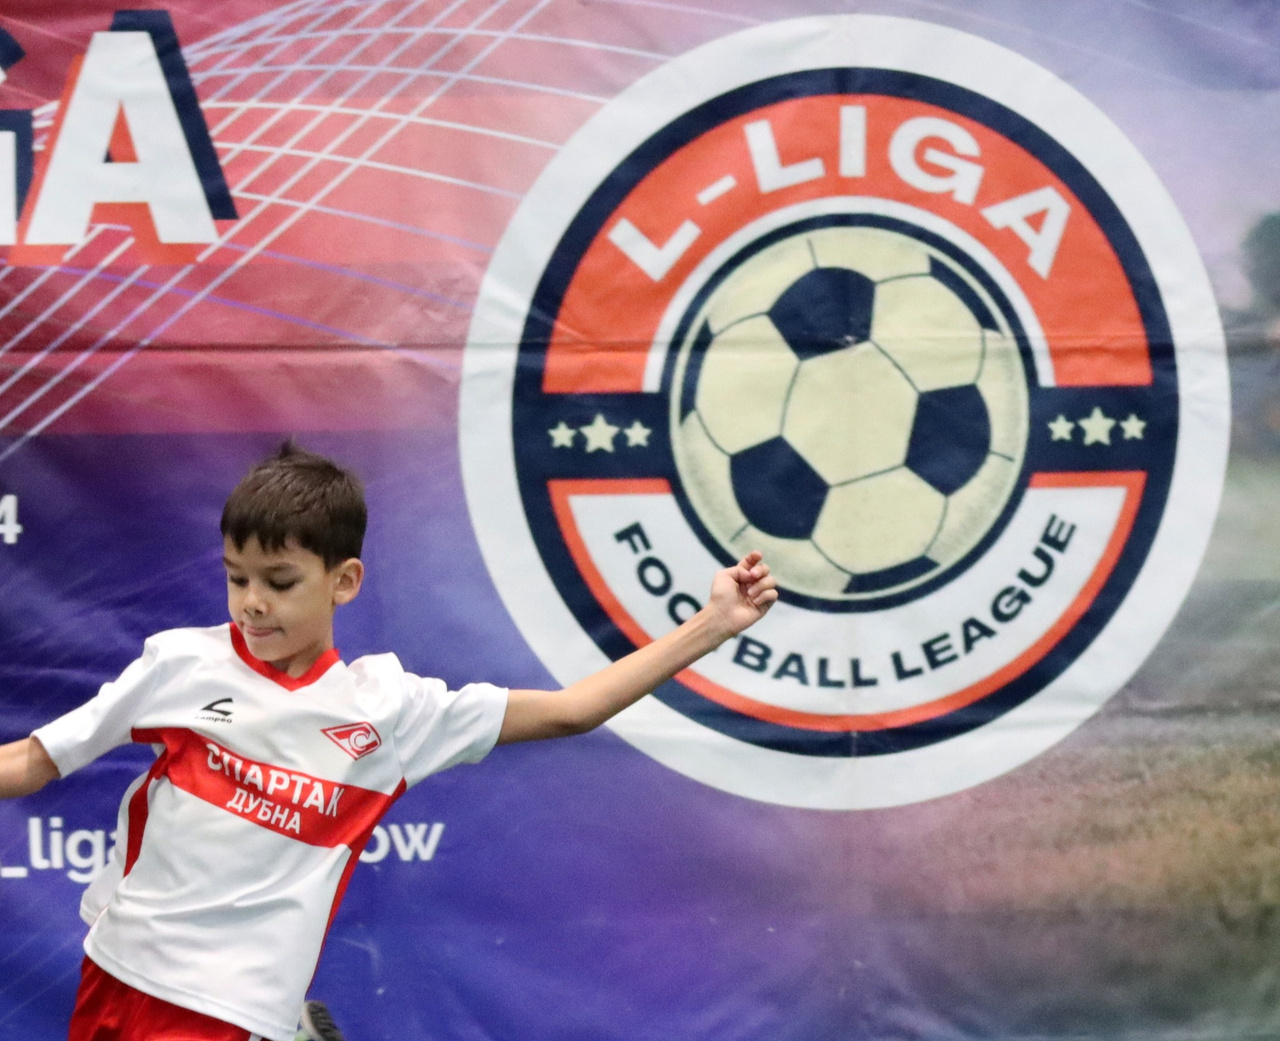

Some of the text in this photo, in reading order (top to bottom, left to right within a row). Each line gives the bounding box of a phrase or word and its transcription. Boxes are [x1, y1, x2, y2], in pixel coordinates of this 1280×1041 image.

[606, 104, 1072, 283] L-LIGA
[614, 513, 1078, 689] FOOBALL LEAGUE
[205, 743, 345, 818] СПАРТАК
[225, 787, 301, 834] ДУБНА
